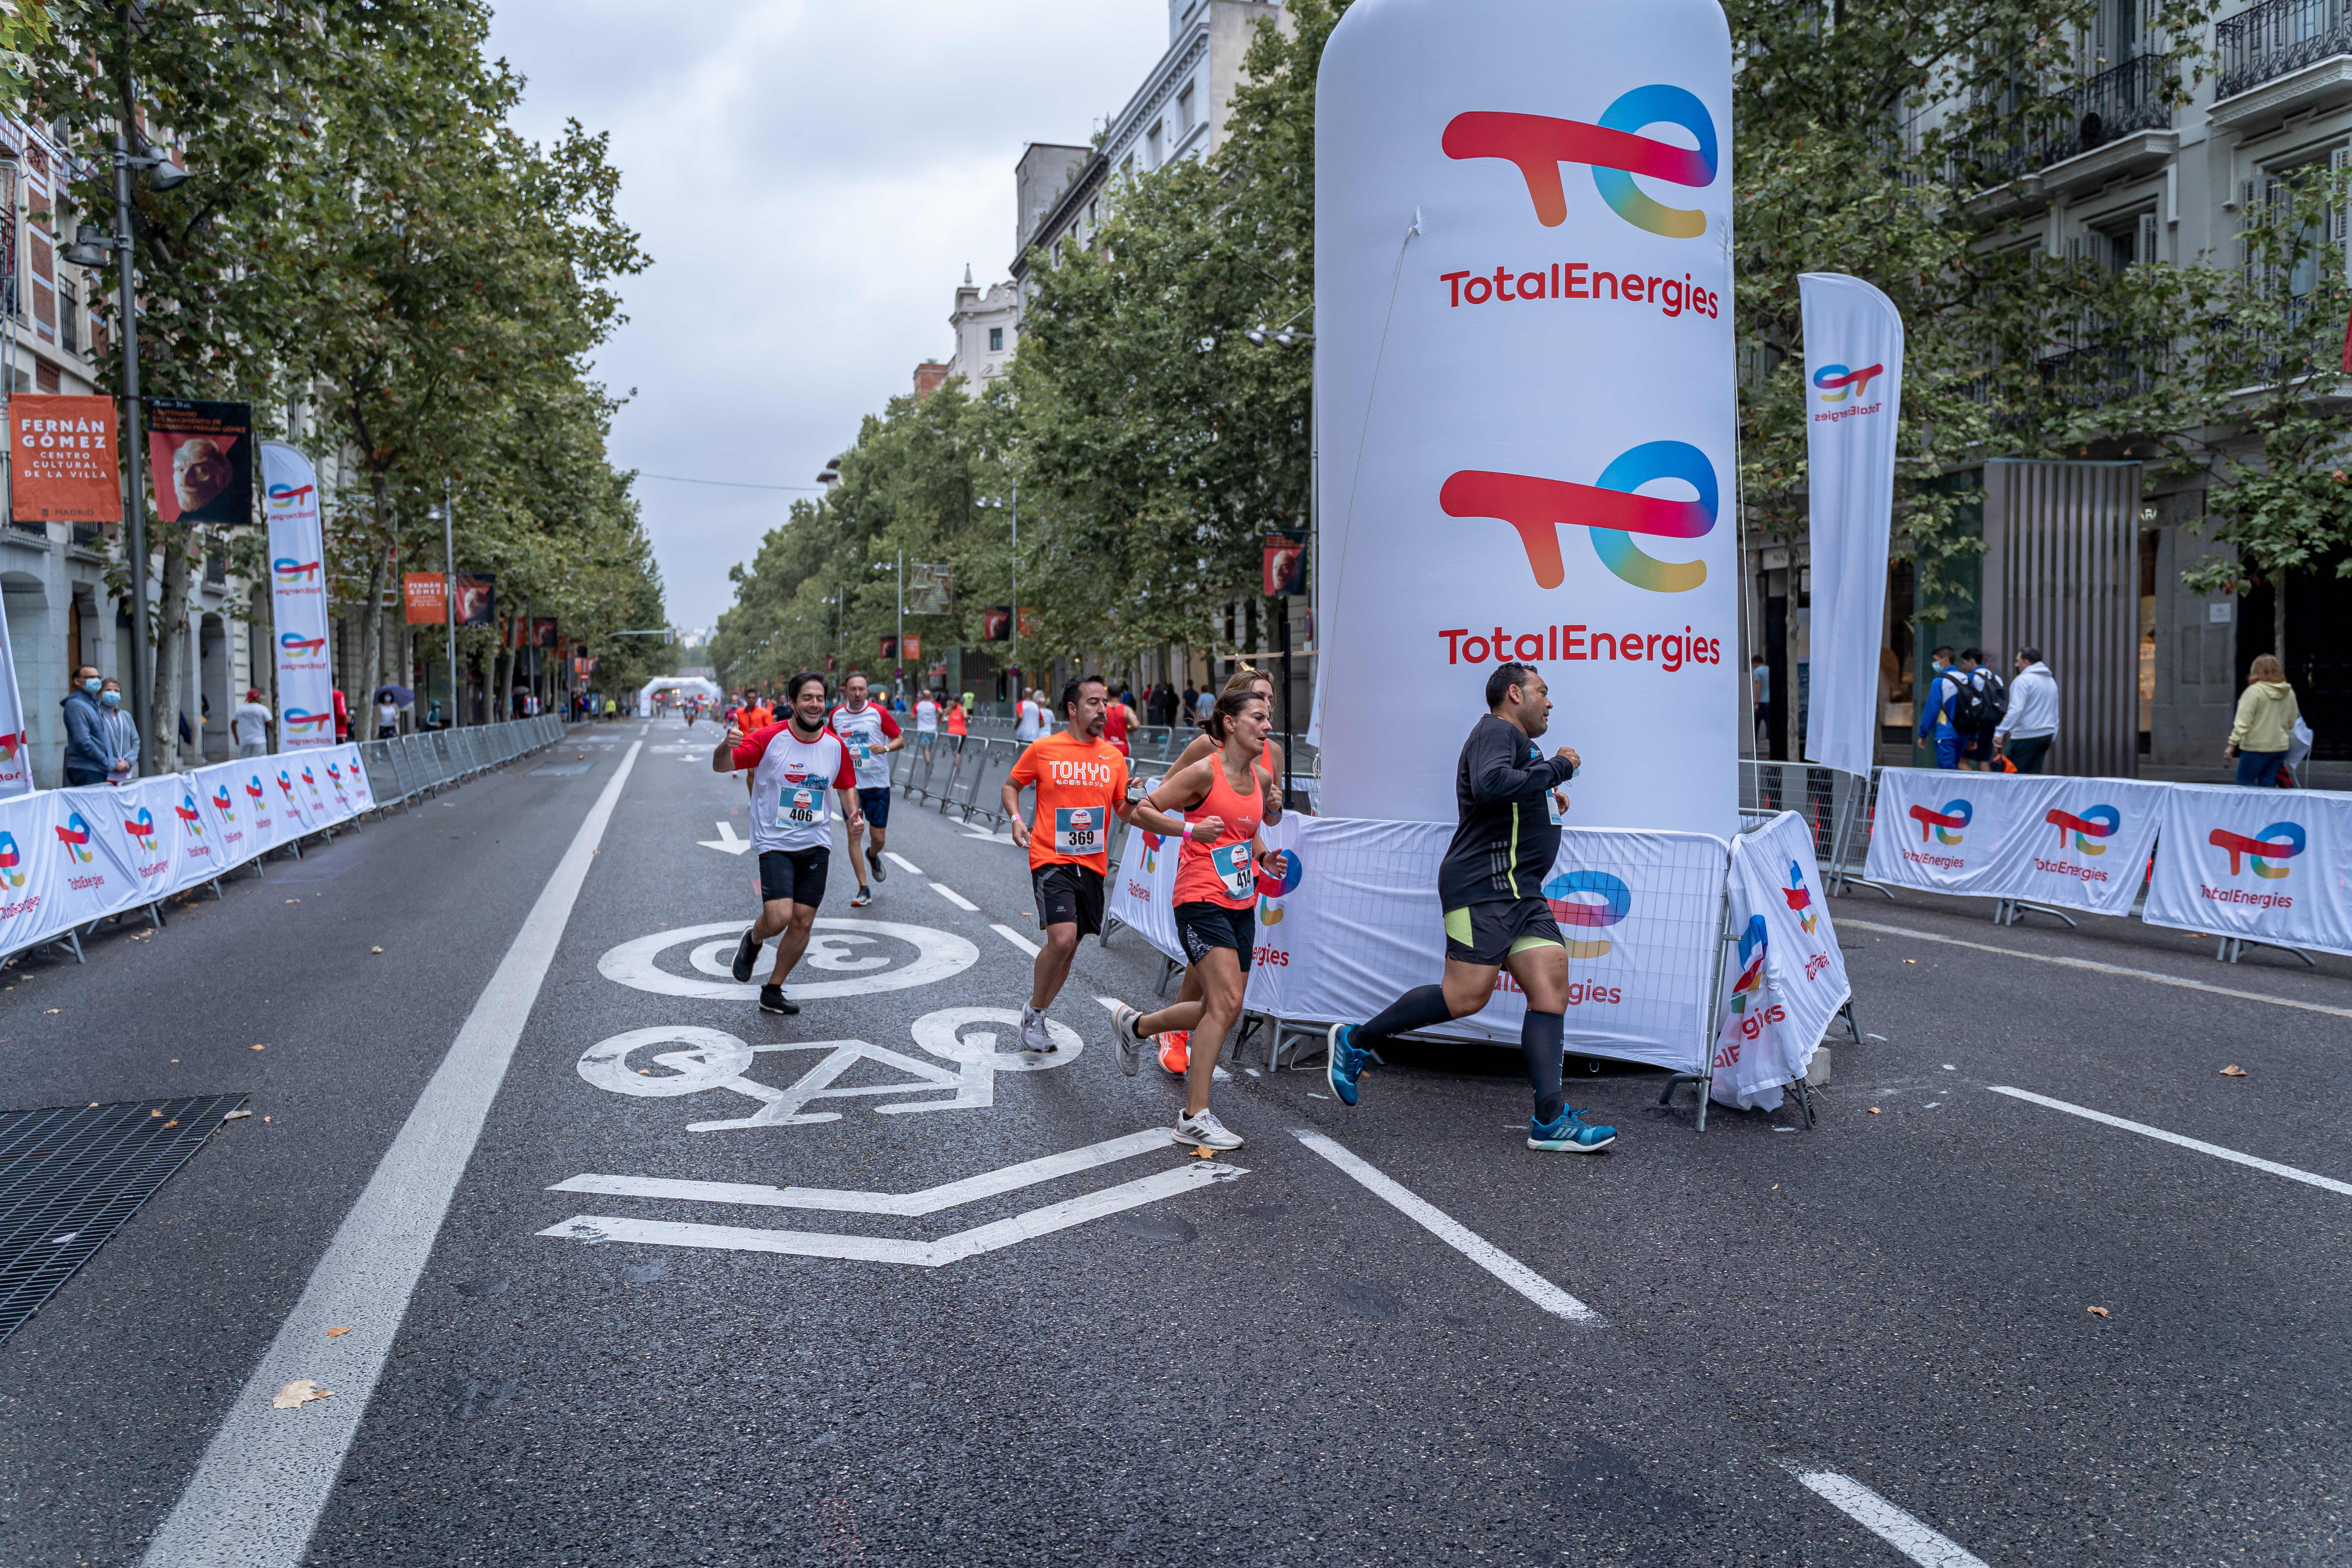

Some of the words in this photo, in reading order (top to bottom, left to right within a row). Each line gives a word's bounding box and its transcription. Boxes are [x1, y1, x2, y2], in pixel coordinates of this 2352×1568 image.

[1440, 263, 1719, 319] TotalEnergies
[22, 417, 105, 433] FERNÁN
[22, 432, 105, 449] GÓMEZ
[1439, 625, 1720, 673] TotalEnergies
[851, 759, 862, 768] 10
[1049, 761, 1111, 783] TOKYO
[789, 809, 813, 822] 406
[1069, 831, 1094, 846] 369
[1237, 869, 1251, 889] 414
